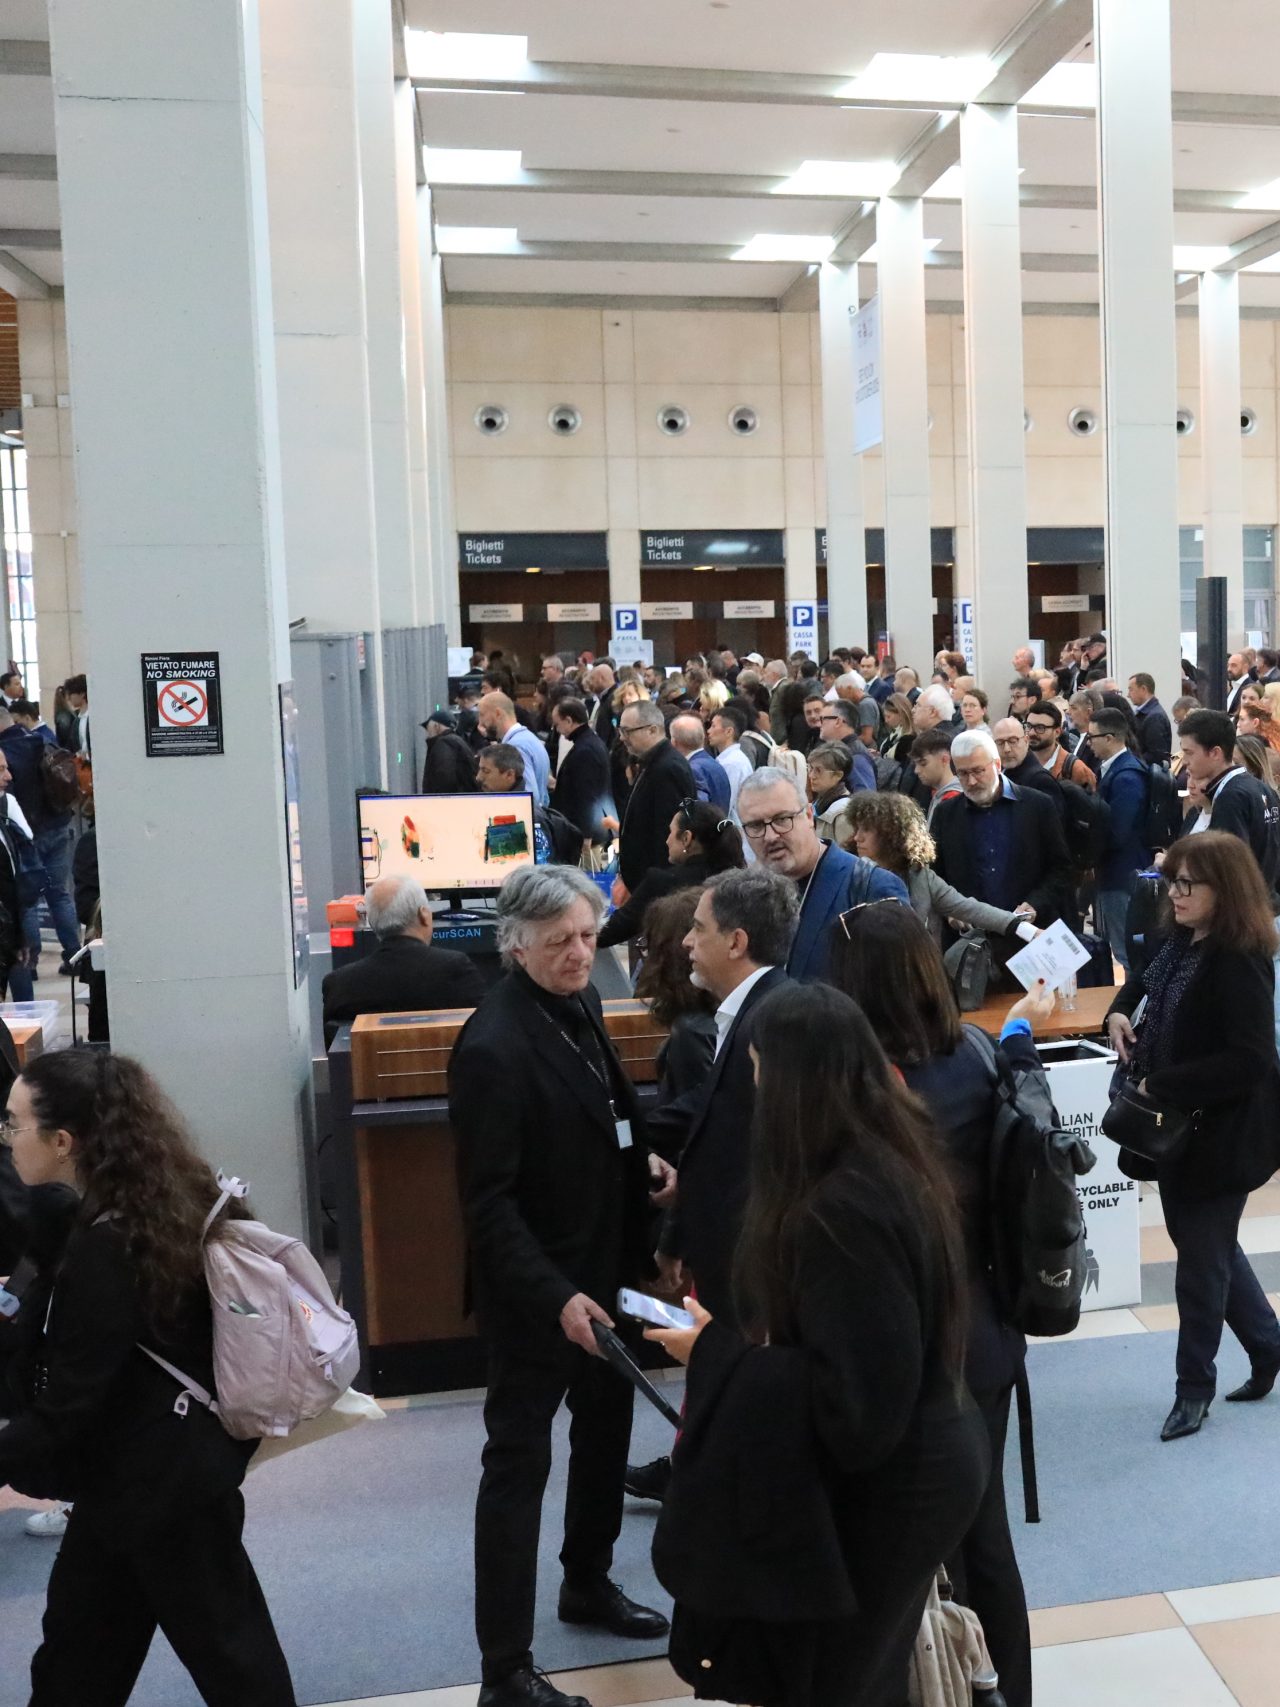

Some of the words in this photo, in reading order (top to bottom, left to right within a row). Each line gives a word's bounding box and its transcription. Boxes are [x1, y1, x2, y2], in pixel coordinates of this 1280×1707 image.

[647, 536, 684, 549] Biglietti
[465, 553, 502, 564] Tickets
[647, 550, 682, 561] Tickets
[145, 661, 179, 670] VIETATO
[181, 660, 215, 669] FUMARE
[146, 670, 163, 679] NO
[165, 669, 216, 678] SMOKING
[432, 927, 481, 940] curSCAN
[1061, 1112, 1093, 1126] LIAN
[1075, 1181, 1134, 1197] CYCLABLE
[1088, 1197, 1120, 1210] ONLY
